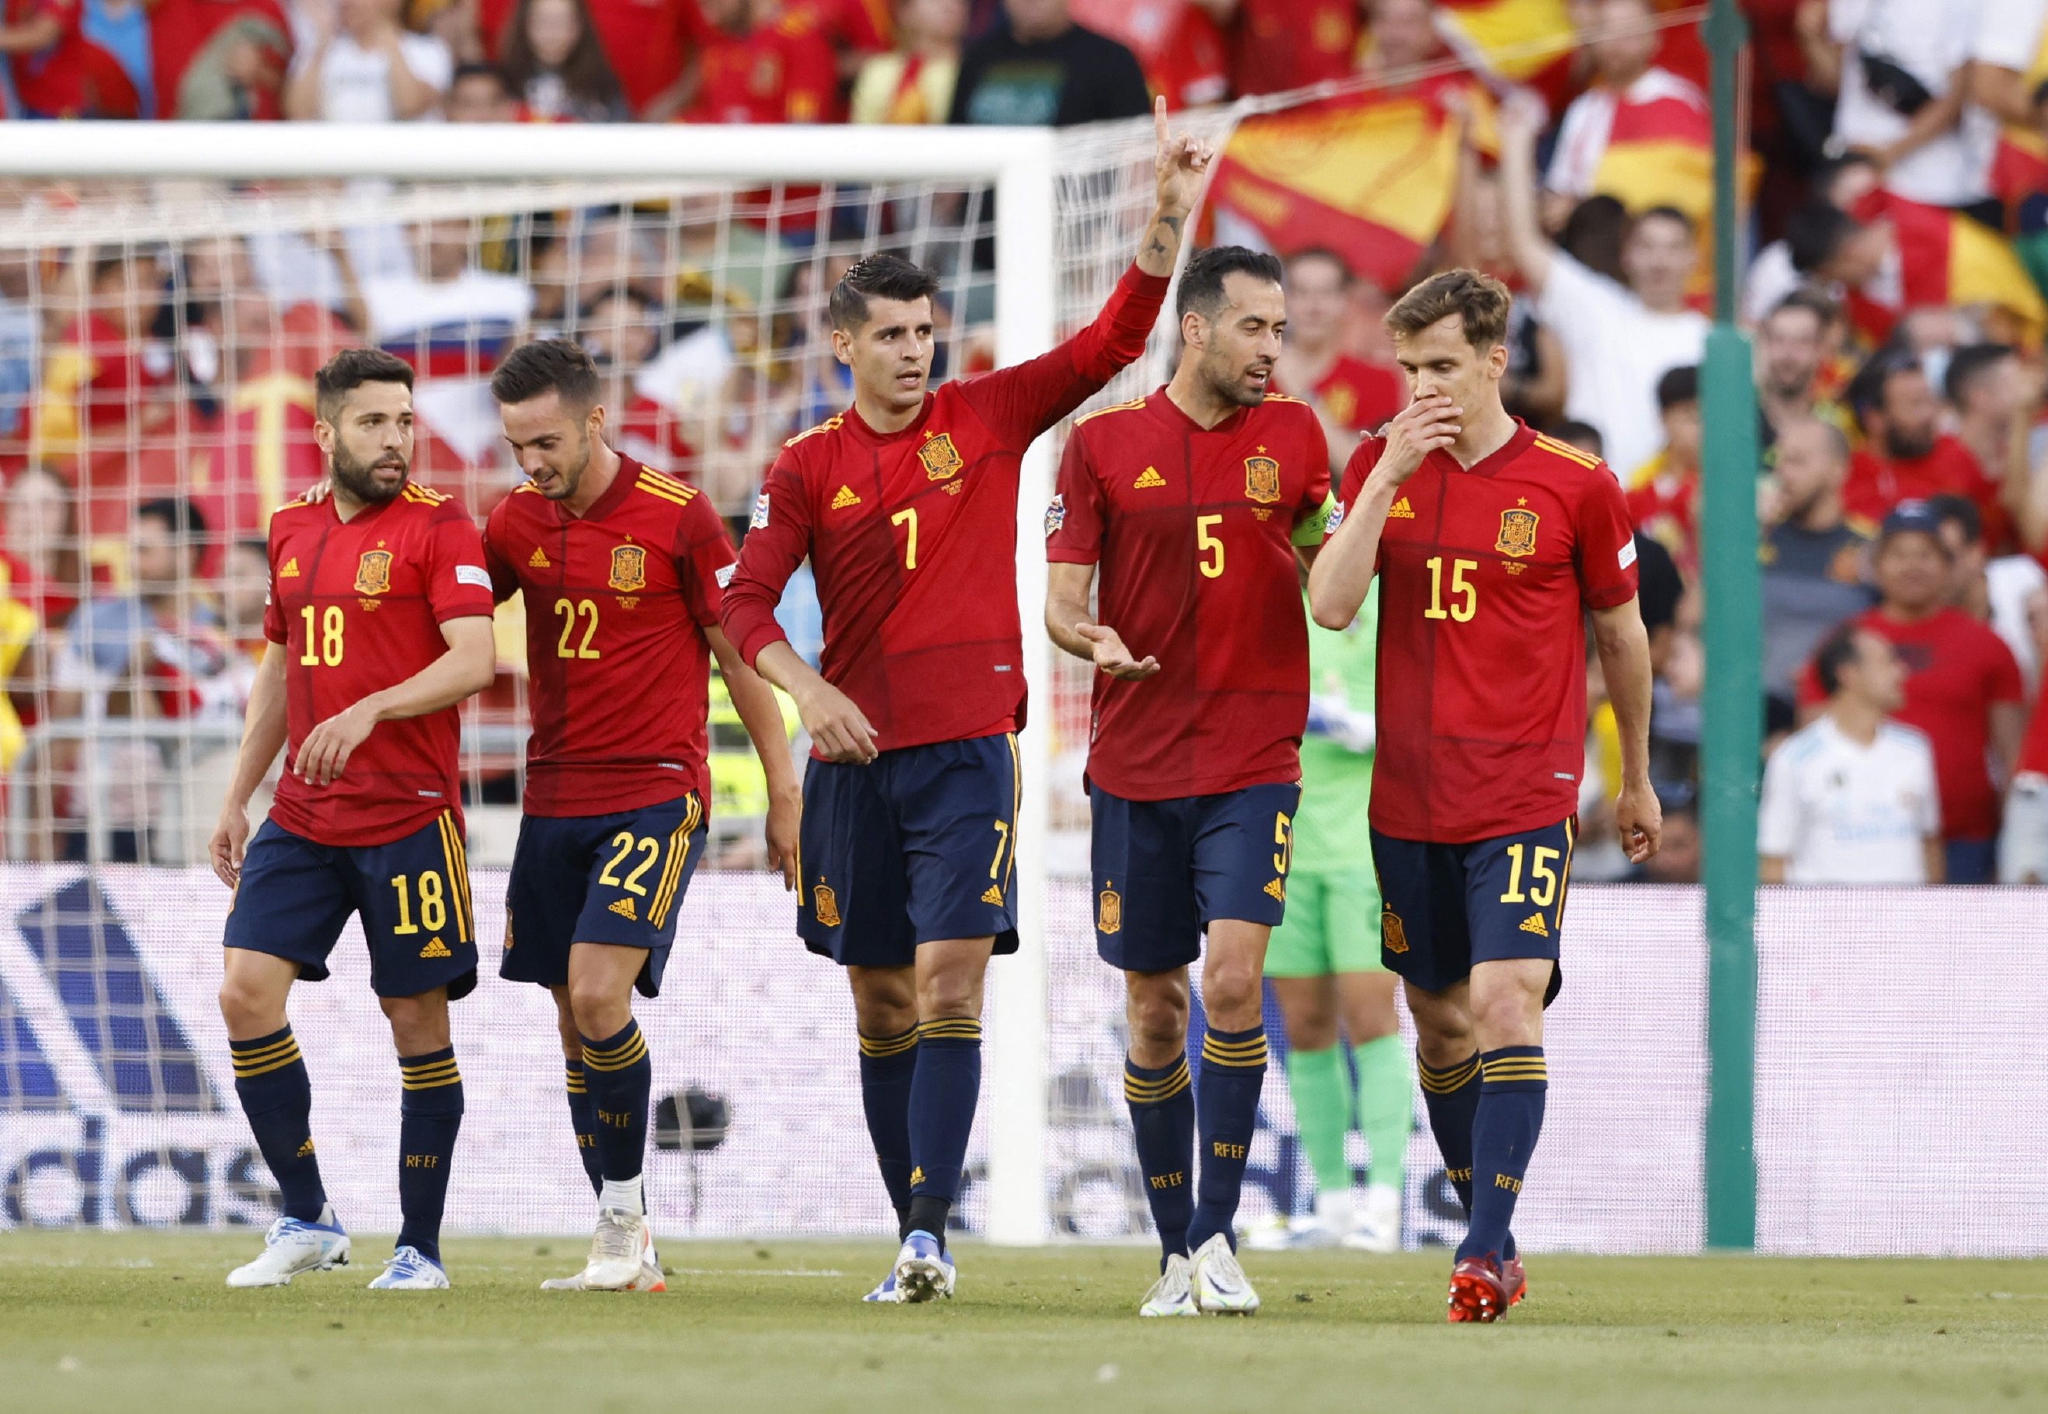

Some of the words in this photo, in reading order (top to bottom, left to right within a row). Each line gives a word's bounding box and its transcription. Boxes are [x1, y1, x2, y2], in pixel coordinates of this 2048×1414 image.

[831, 496, 861, 510] adidas
[1133, 478, 1167, 489] adidas
[890, 507, 918, 570] 7
[1196, 513, 1225, 579] 5
[1424, 556, 1478, 623] 15
[300, 605, 345, 667] 18
[554, 598, 600, 659] 22
[598, 831, 660, 897] 22
[989, 819, 1009, 880] 7
[1273, 811, 1291, 875] 5
[391, 870, 447, 935] 18
[1500, 843, 1560, 907] 15
[608, 904, 638, 921] adidas
[1518, 922, 1549, 938] adidas
[419, 949, 452, 958] adidas
[598, 1109, 632, 1128] RFEF
[405, 1154, 440, 1169] RFEF
[1149, 1171, 1184, 1190] RFEF
[1213, 1141, 1245, 1159] RFEF
